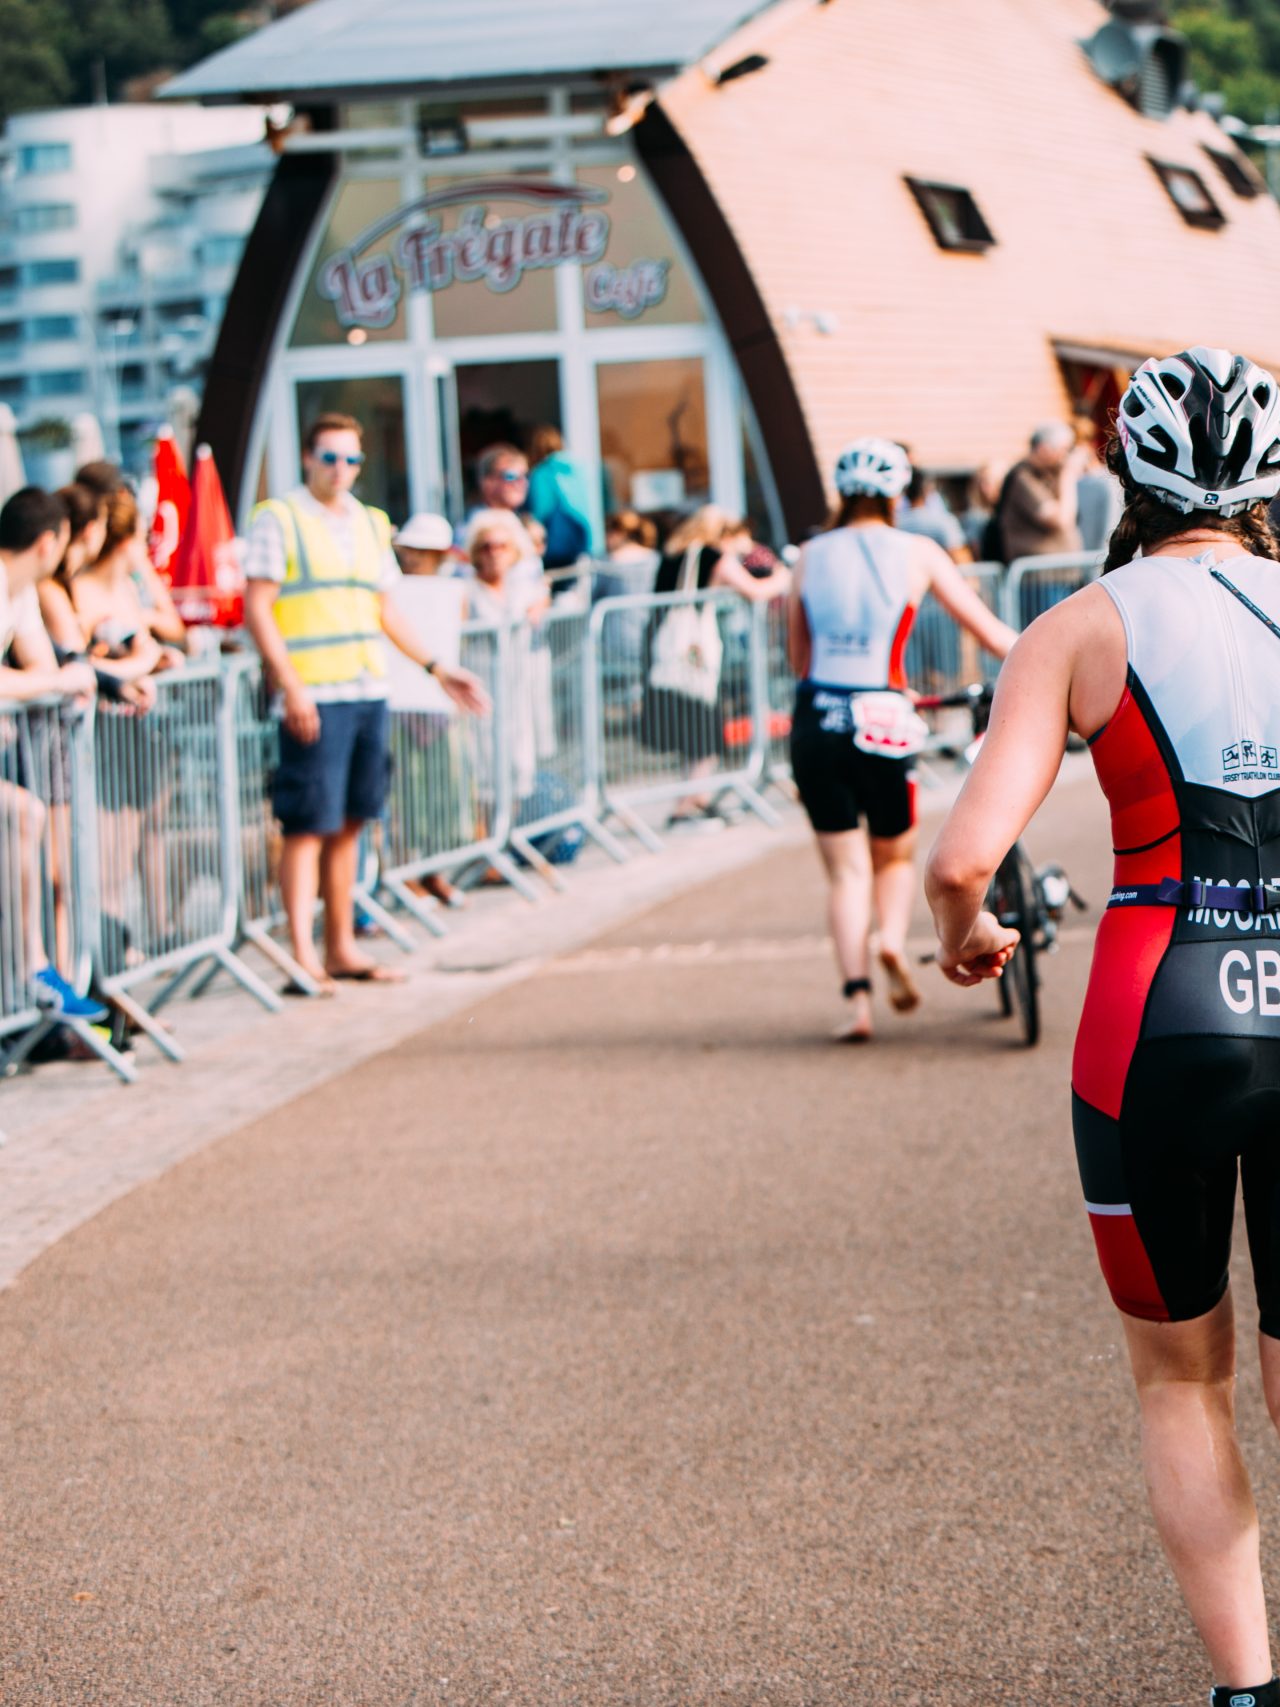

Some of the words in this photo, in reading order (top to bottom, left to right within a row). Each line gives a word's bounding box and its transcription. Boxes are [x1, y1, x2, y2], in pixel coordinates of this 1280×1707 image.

[320, 254, 399, 326] La
[1222, 773, 1240, 784] JERSEY
[1240, 771, 1267, 781] TRIATHLON
[1267, 772, 1280, 781] CLUB
